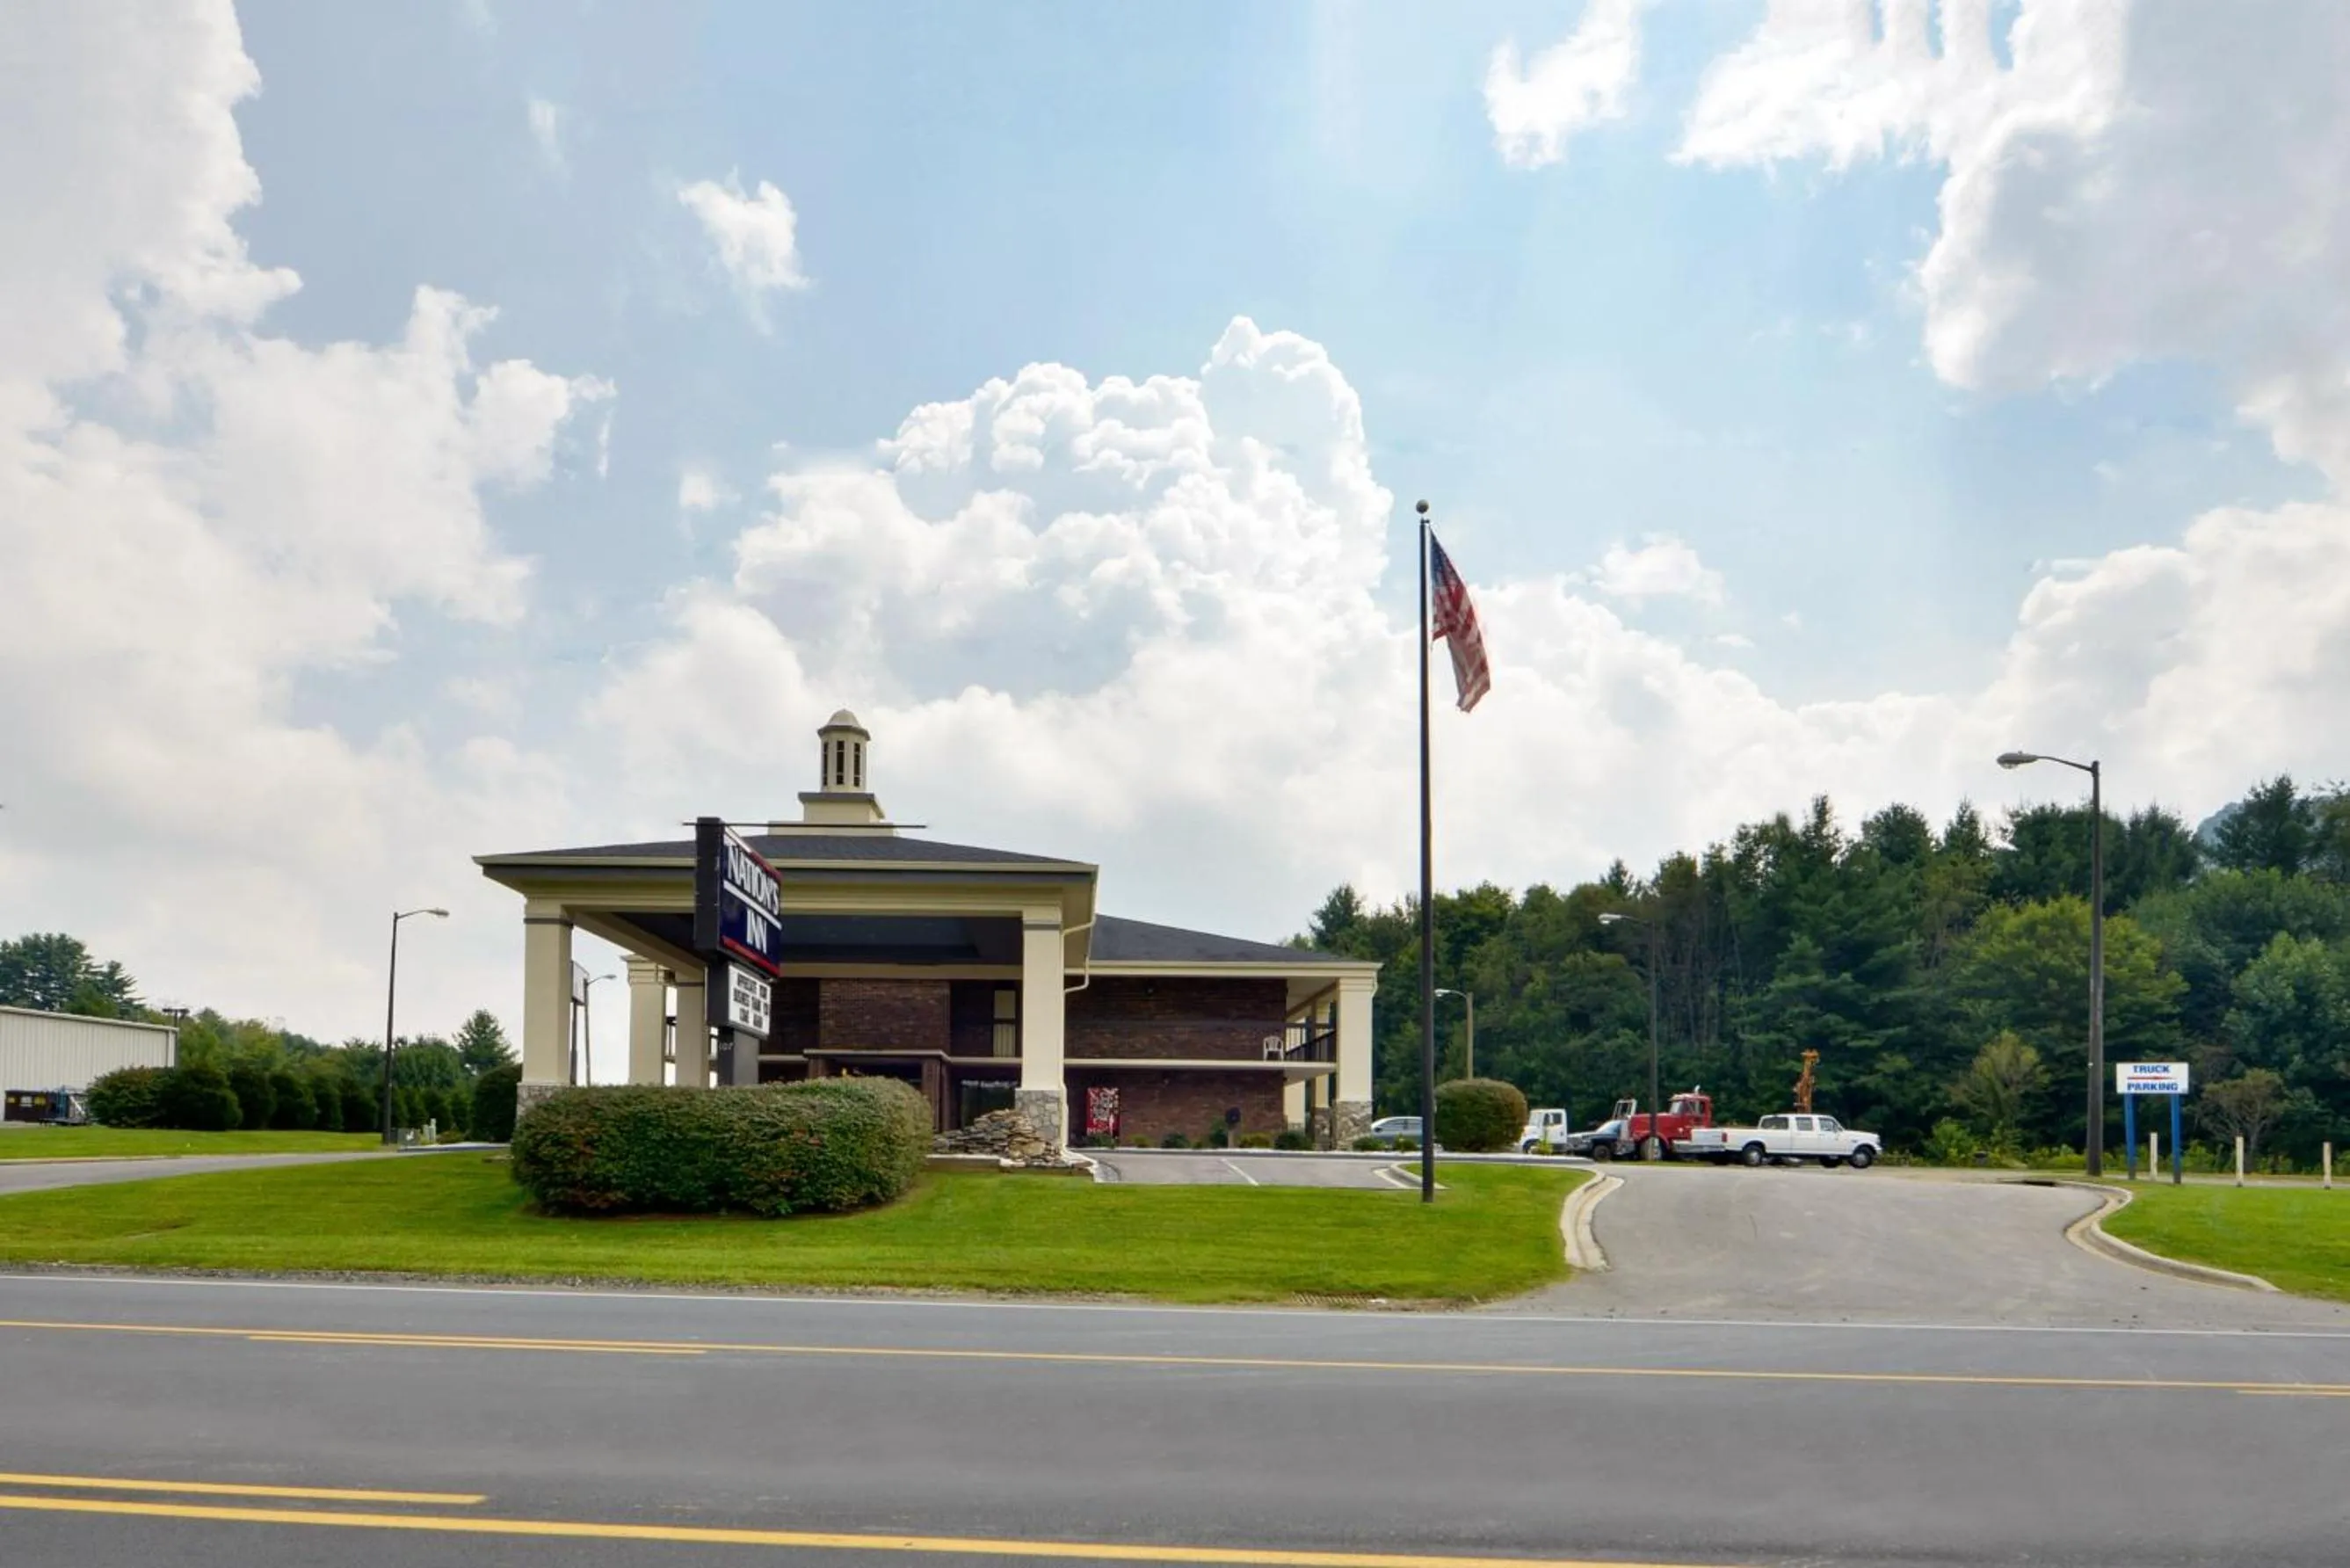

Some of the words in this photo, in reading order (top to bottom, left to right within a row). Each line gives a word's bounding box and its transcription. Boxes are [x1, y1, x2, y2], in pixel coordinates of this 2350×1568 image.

[728, 846, 780, 916] NATION'S
[746, 907, 767, 955] INN
[2127, 1082, 2179, 1091] PARKING
